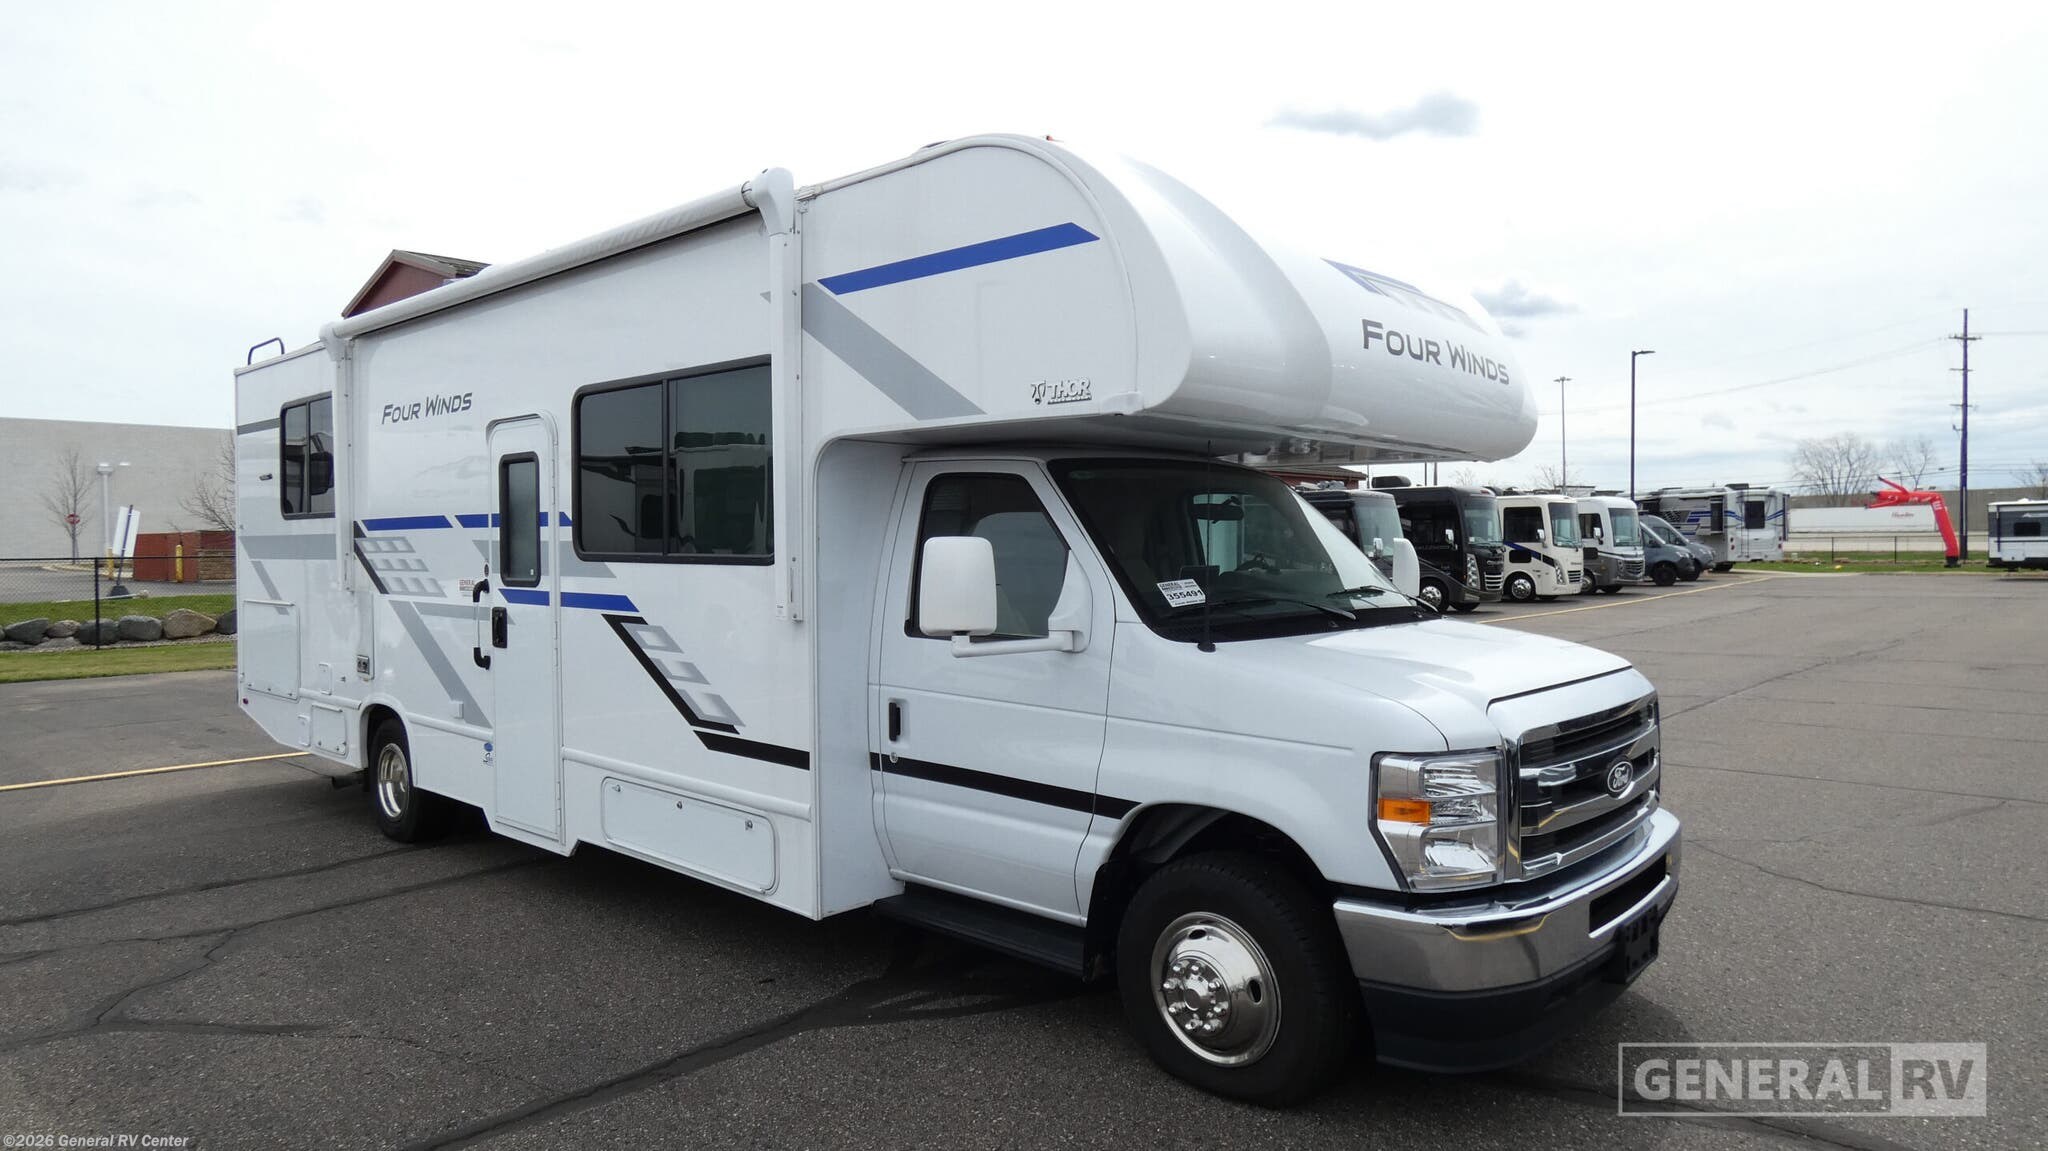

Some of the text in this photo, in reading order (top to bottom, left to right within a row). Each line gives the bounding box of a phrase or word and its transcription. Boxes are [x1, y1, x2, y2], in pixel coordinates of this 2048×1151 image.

[1362, 318, 1510, 385] FOUR WINDS
[1046, 378, 1092, 400] THOR
[381, 392, 473, 425] FOUR WINDS
[1166, 589, 1204, 601] 355491
